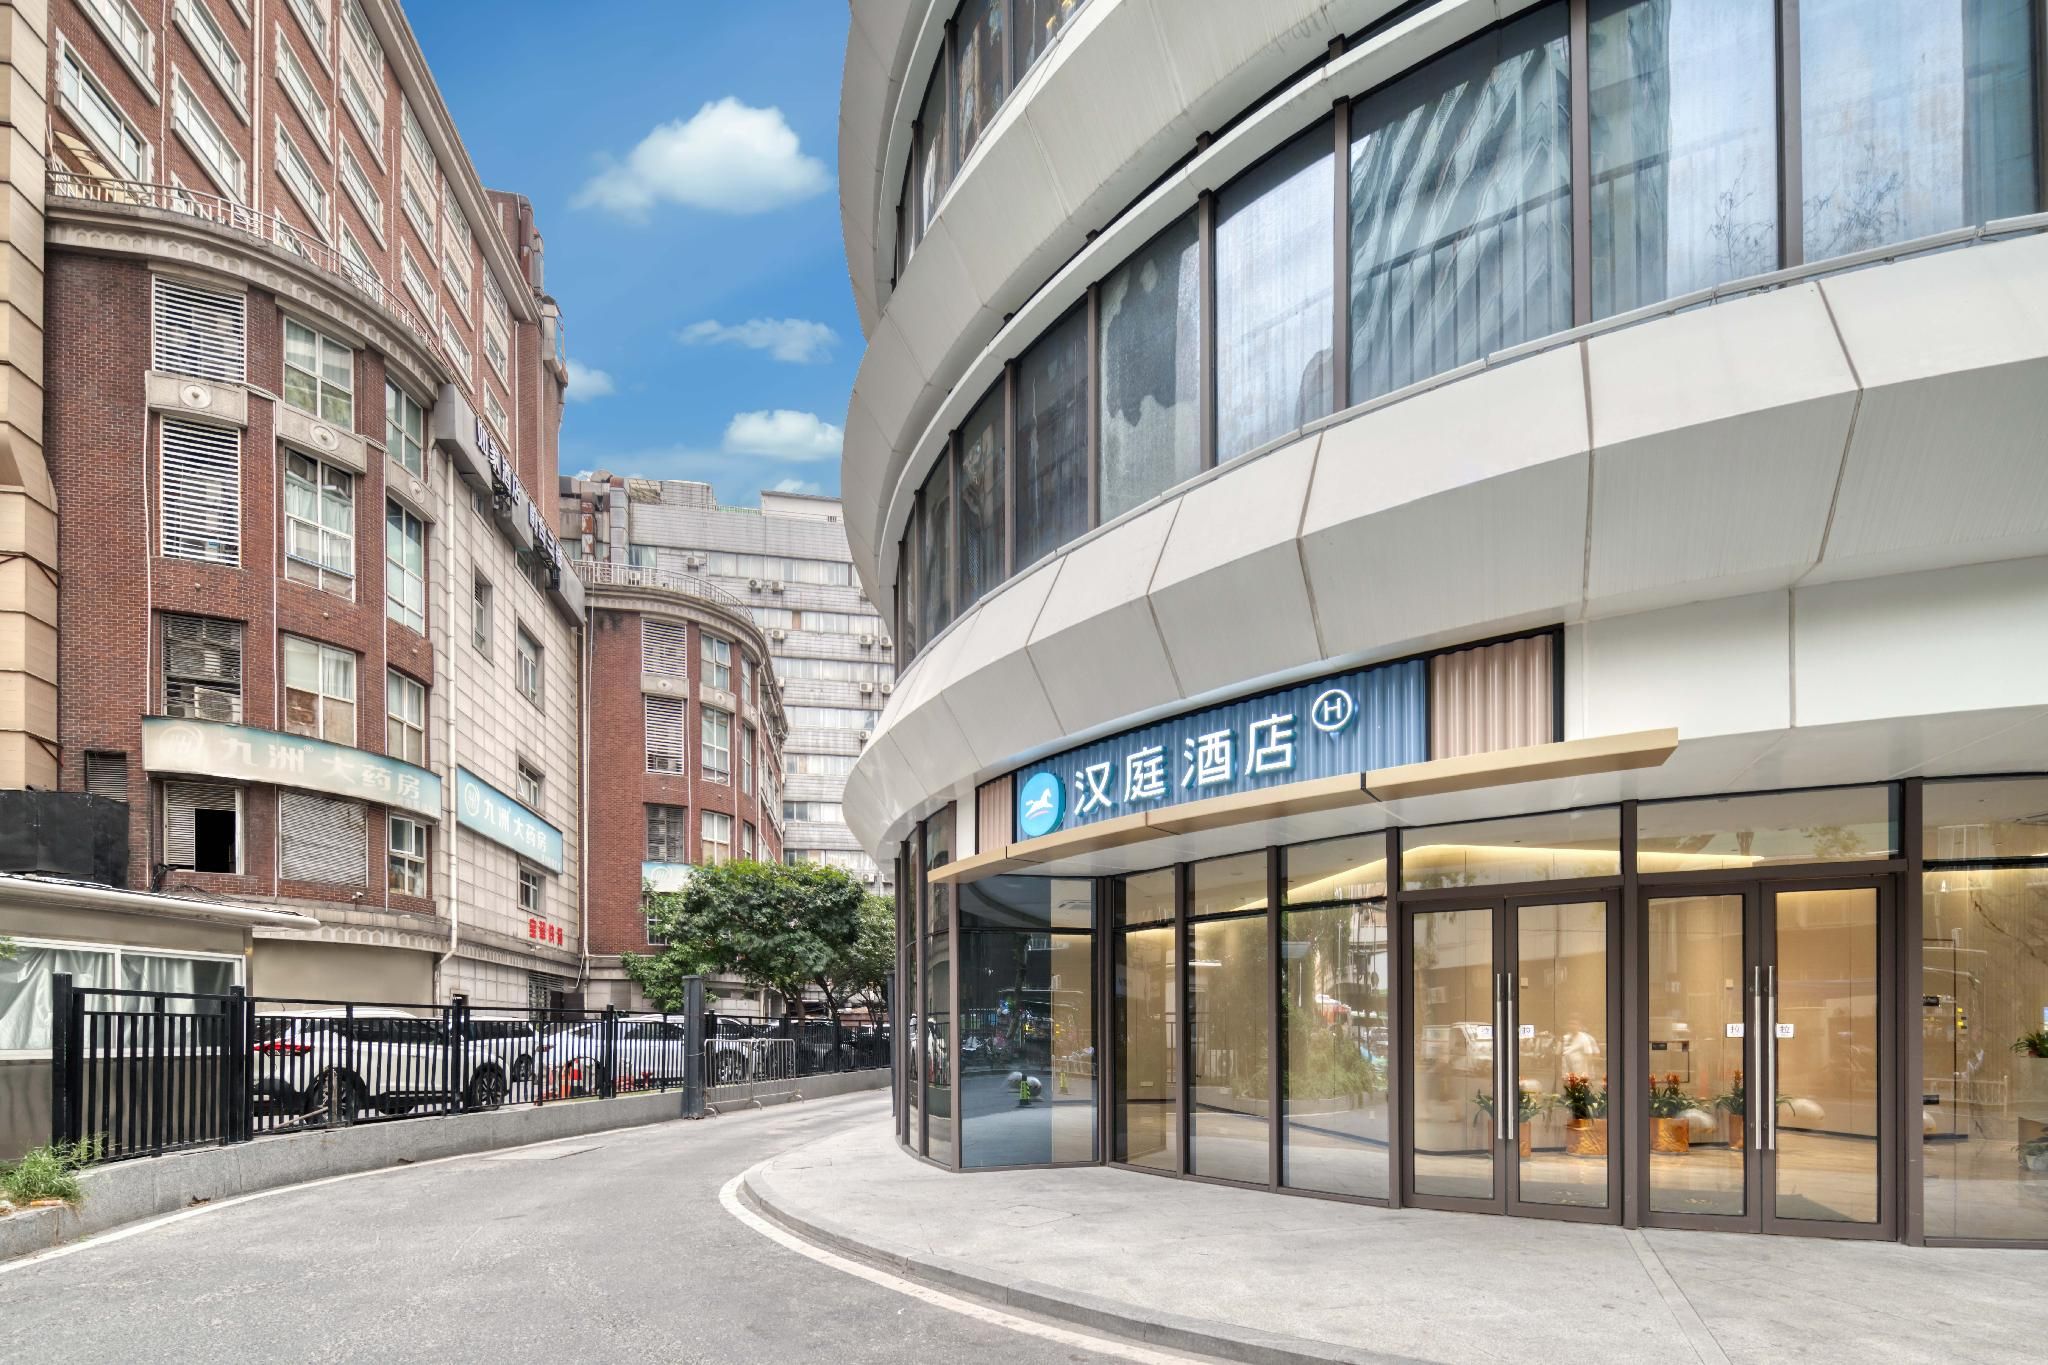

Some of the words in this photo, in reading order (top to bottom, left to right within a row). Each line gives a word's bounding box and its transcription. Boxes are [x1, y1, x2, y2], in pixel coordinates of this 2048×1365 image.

[476, 415, 520, 506] 如家酒店
[218, 736, 420, 800] 九洲大药房
[1073, 713, 1295, 816] 汉庭酒店
[482, 798, 547, 853] 九洲大药房
[1779, 1024, 1791, 1034] 拉
